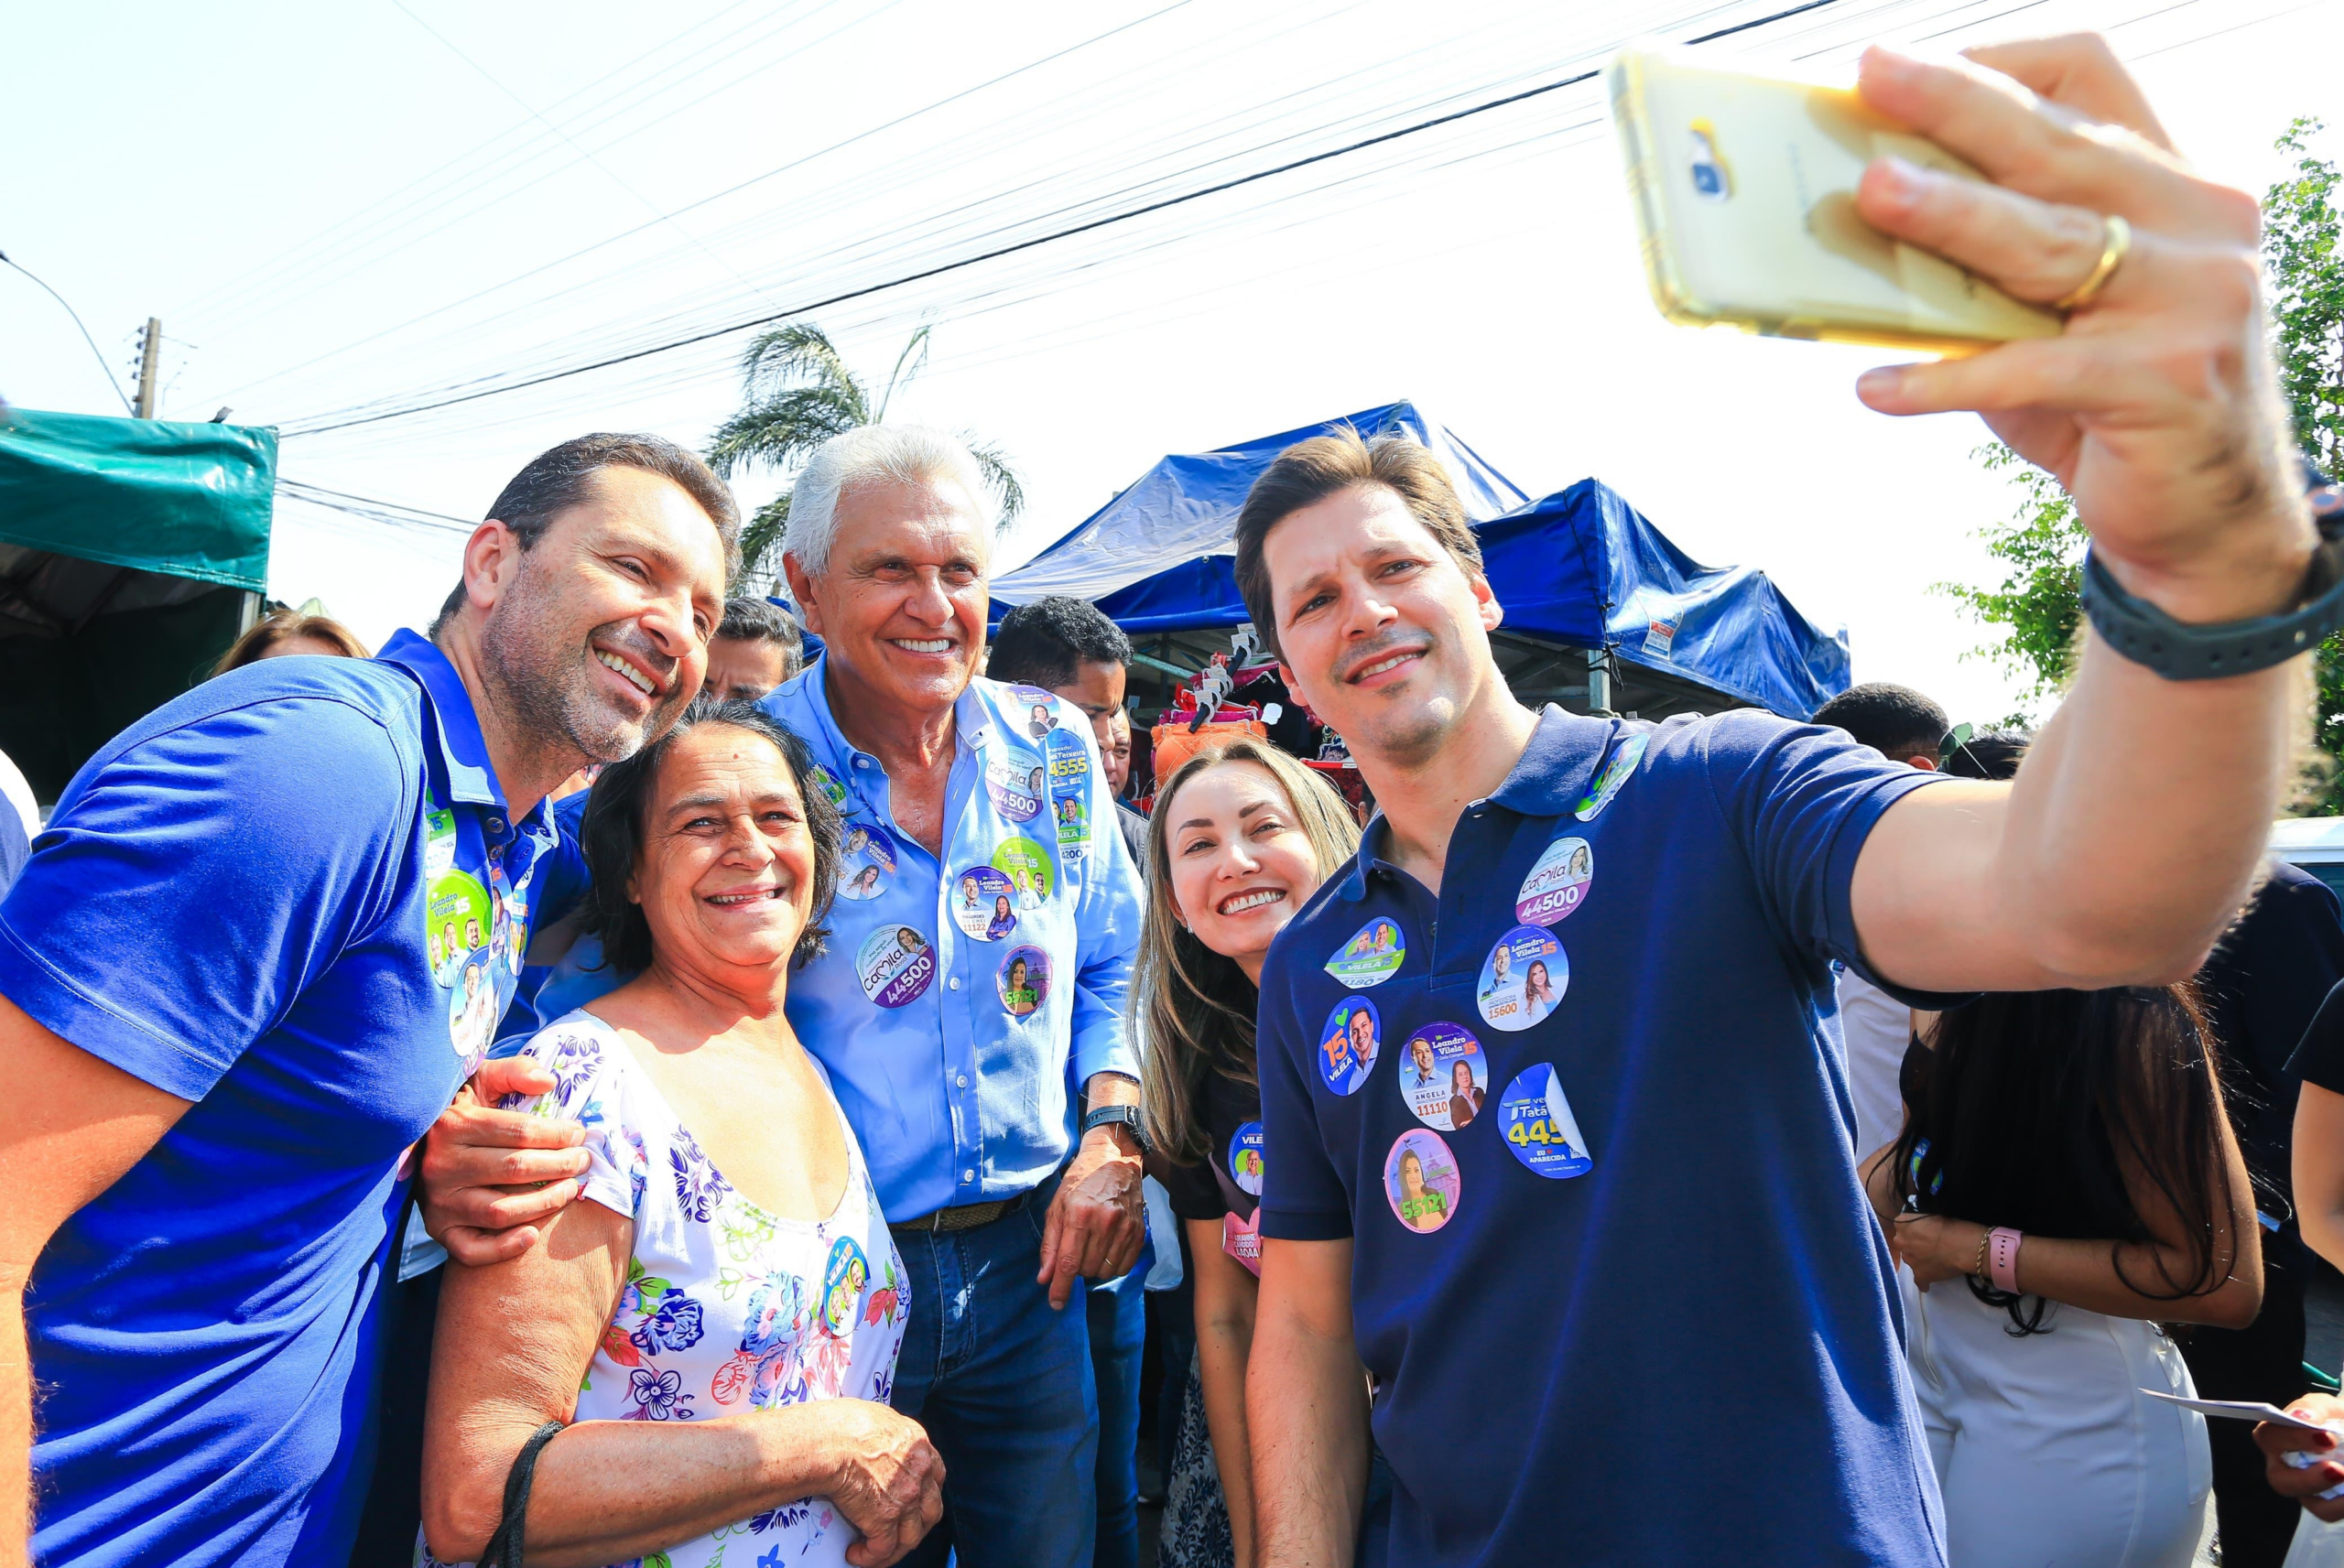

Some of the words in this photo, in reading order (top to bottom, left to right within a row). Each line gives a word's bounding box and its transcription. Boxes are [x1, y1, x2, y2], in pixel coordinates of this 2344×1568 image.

[1058, 750, 1086, 760] Teixeira
[991, 788, 1036, 814] 44500
[868, 840, 891, 861] Leandro
[1027, 859, 1039, 868] 15
[429, 893, 458, 910] Leandro
[434, 904, 455, 917] Vilela
[456, 896, 471, 914] 15
[1522, 886, 1579, 917] 44500
[1511, 938, 1545, 953] Leandro
[1515, 946, 1541, 957] Vilela
[1541, 941, 1557, 956] 15
[1347, 960, 1382, 970] VILELA
[1381, 956, 1394, 967] 15
[886, 957, 931, 1004] 44500
[1006, 989, 1038, 1005] 55121
[1489, 1002, 1517, 1020] 15600
[1323, 1027, 1348, 1068] 15
[1431, 1037, 1466, 1049] Leandro
[1438, 1045, 1463, 1055] Vilela
[1463, 1041, 1478, 1055] 15
[1329, 1056, 1354, 1082] VILELA
[1416, 1090, 1446, 1100] ANGELA
[1417, 1101, 1448, 1117] 11110
[1529, 1154, 1567, 1163] APARECIDA
[1402, 1191, 1447, 1220] 55121
